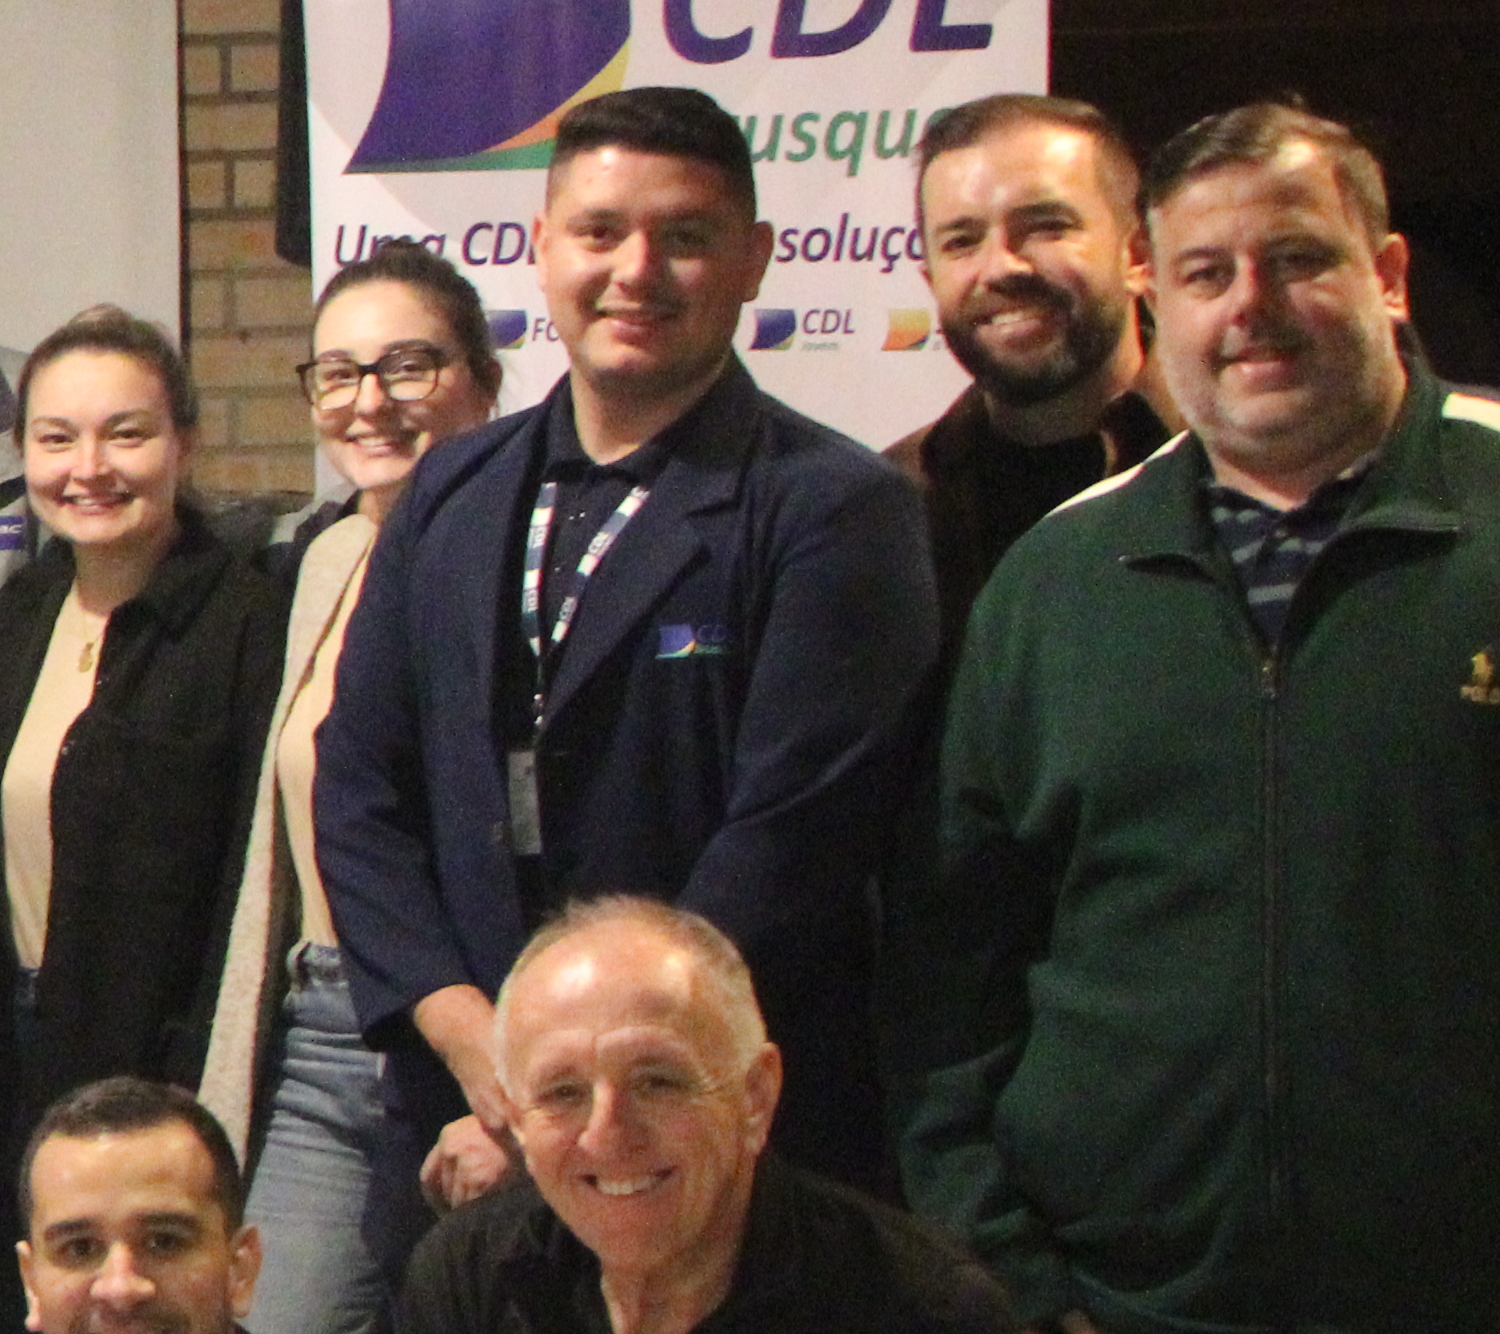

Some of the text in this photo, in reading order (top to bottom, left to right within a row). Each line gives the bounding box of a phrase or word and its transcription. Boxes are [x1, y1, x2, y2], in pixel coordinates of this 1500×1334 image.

[734, 107, 955, 178] usqu
[774, 212, 927, 274] soluç
[802, 309, 856, 335] CDL
